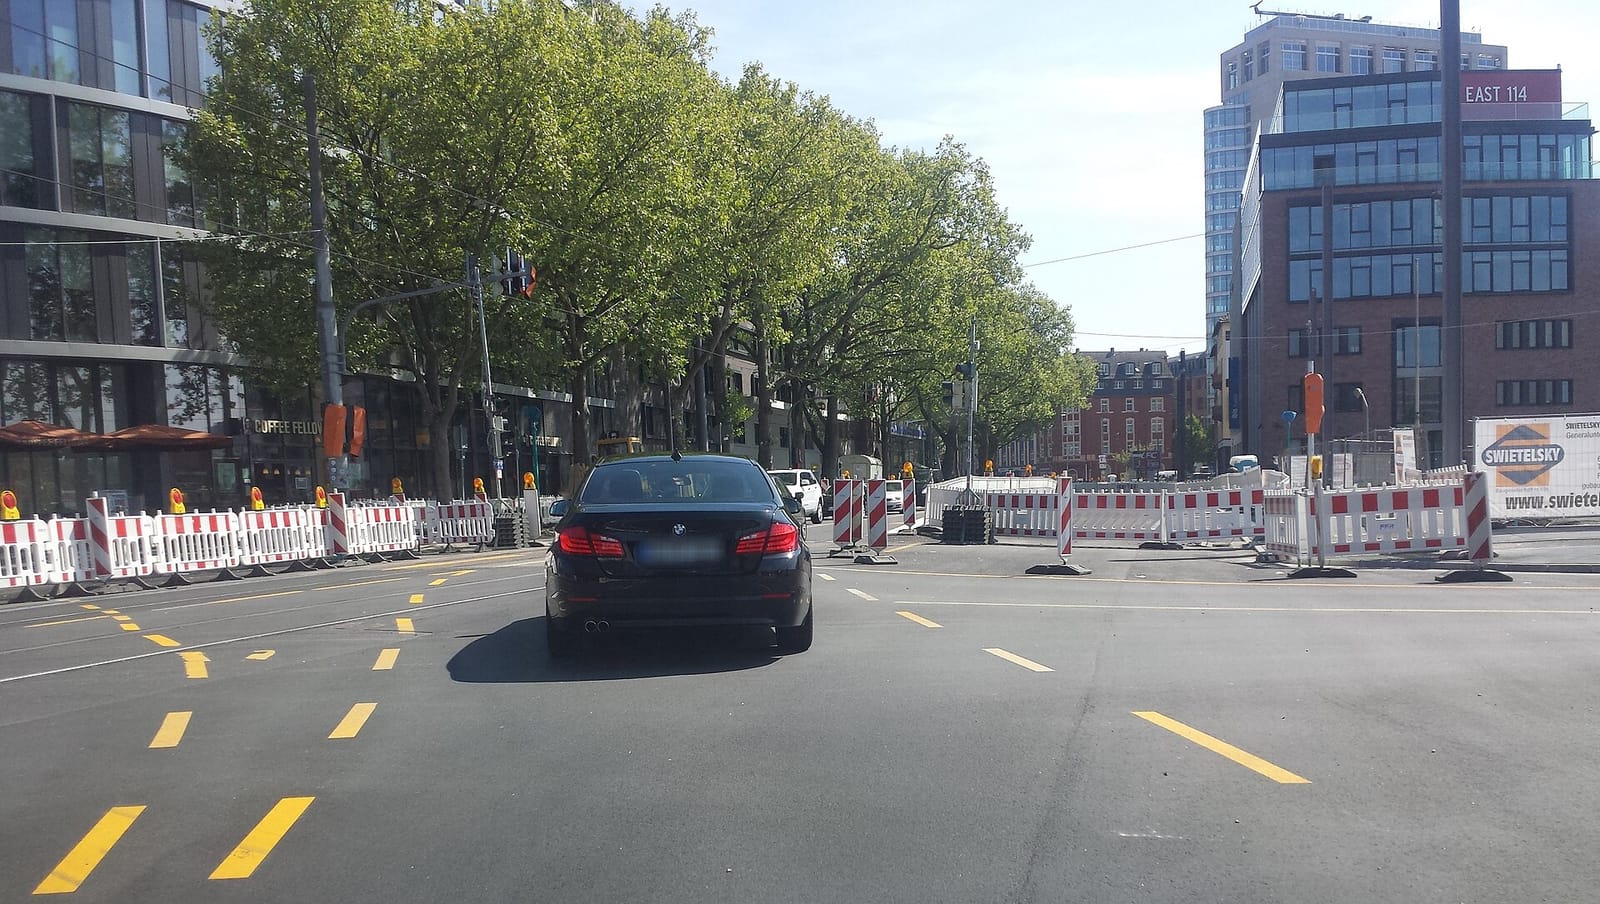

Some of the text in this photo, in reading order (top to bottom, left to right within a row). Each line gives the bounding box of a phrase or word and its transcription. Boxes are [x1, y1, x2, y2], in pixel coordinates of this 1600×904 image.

[1466, 86, 1527, 102] EAST 114
[255, 419, 290, 433] COFFEE
[1485, 448, 1560, 463] SWIETELSKY
